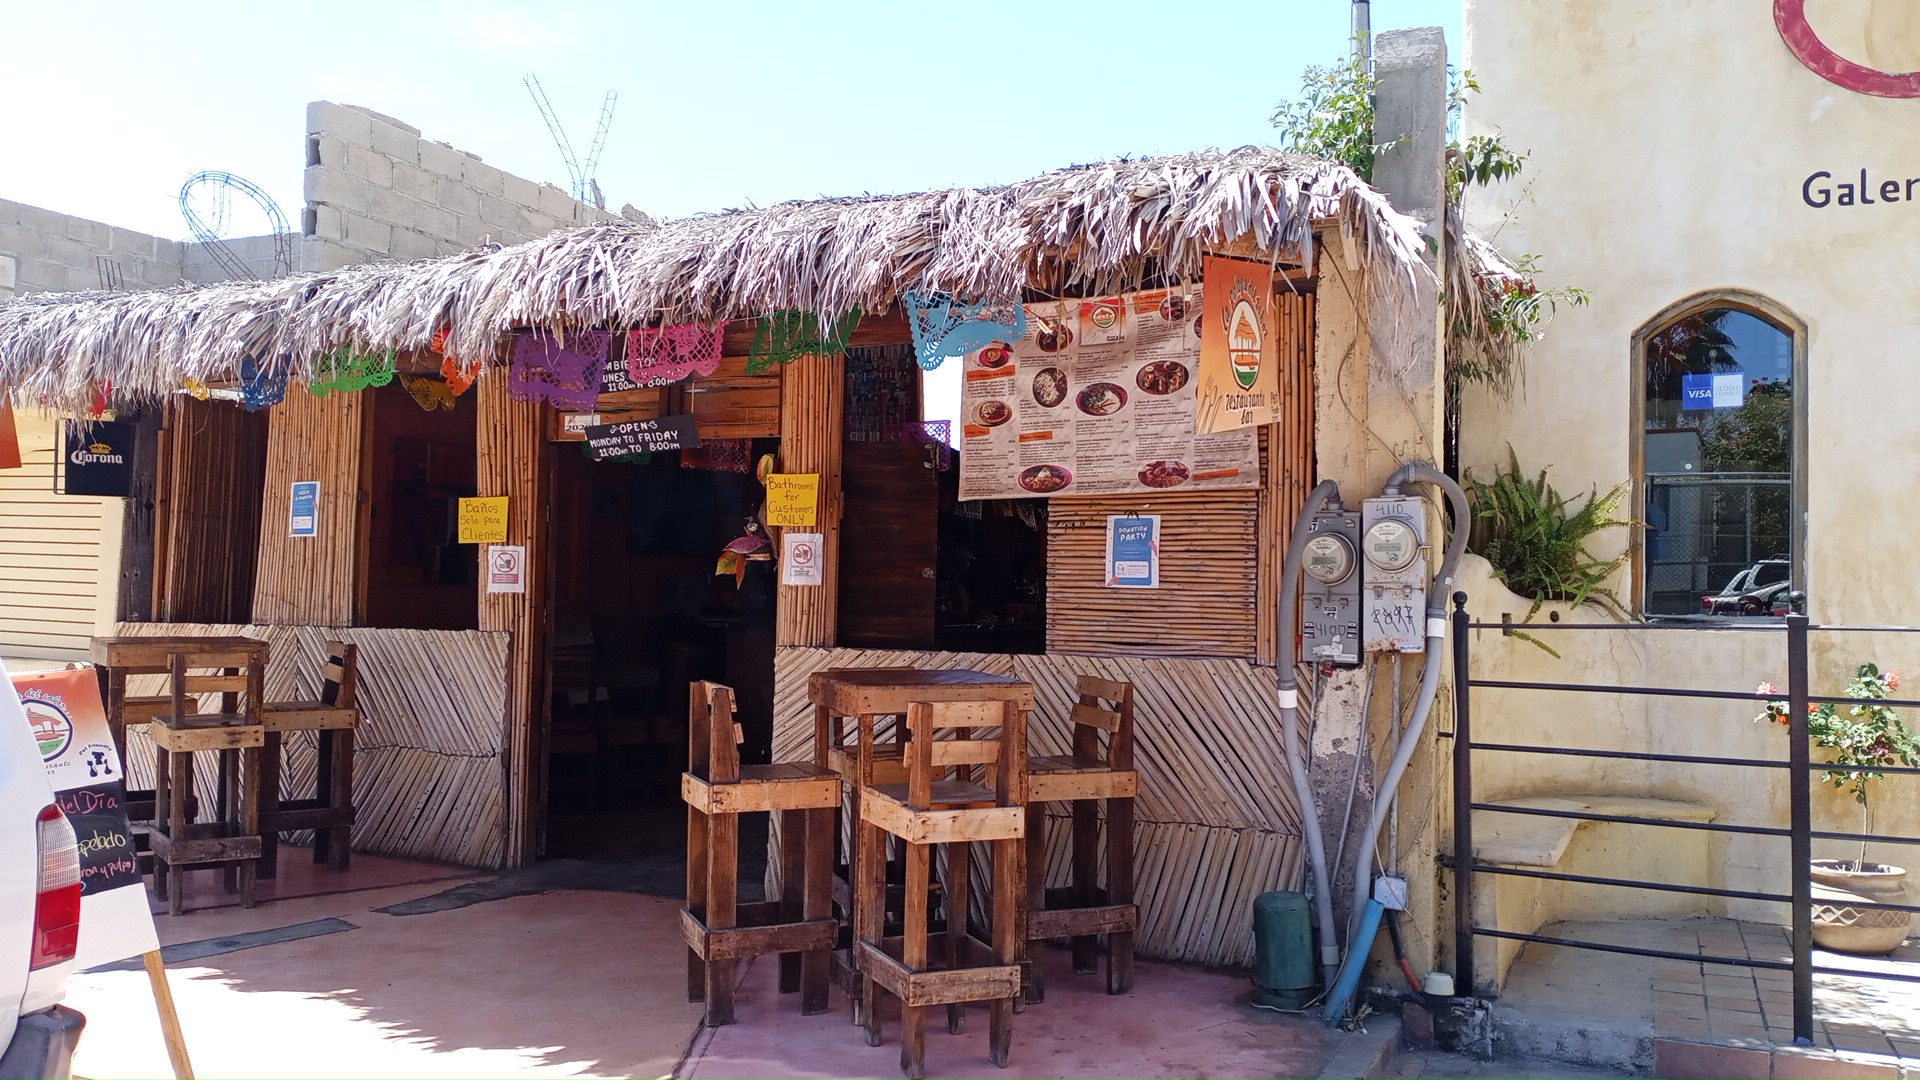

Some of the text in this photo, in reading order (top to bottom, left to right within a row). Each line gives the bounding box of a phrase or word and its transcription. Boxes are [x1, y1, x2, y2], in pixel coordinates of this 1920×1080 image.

[601, 371, 626, 383] UNES
[1687, 389, 1712, 399] VISA
[619, 421, 648, 434] OPEN
[589, 430, 679, 449] MONDAY TO FRIDAY
[629, 444, 642, 453] TO
[70, 449, 124, 467] Corona
[767, 476, 815, 491] Bathrooms
[784, 490, 801, 501] for
[464, 500, 499, 514] Baños
[768, 500, 815, 515] Customers
[1375, 503, 1405, 515] 4110
[460, 515, 501, 525] Solo para
[776, 513, 805, 526] ONLY
[461, 527, 505, 541] Clientes
[1118, 525, 1149, 534] DONATION
[1120, 532, 1146, 542] PARTY
[1315, 623, 1347, 637] 4100
[25, 688, 41, 699] del
[79, 742, 113, 757] Pet Friendly
[100, 866, 110, 879] y
